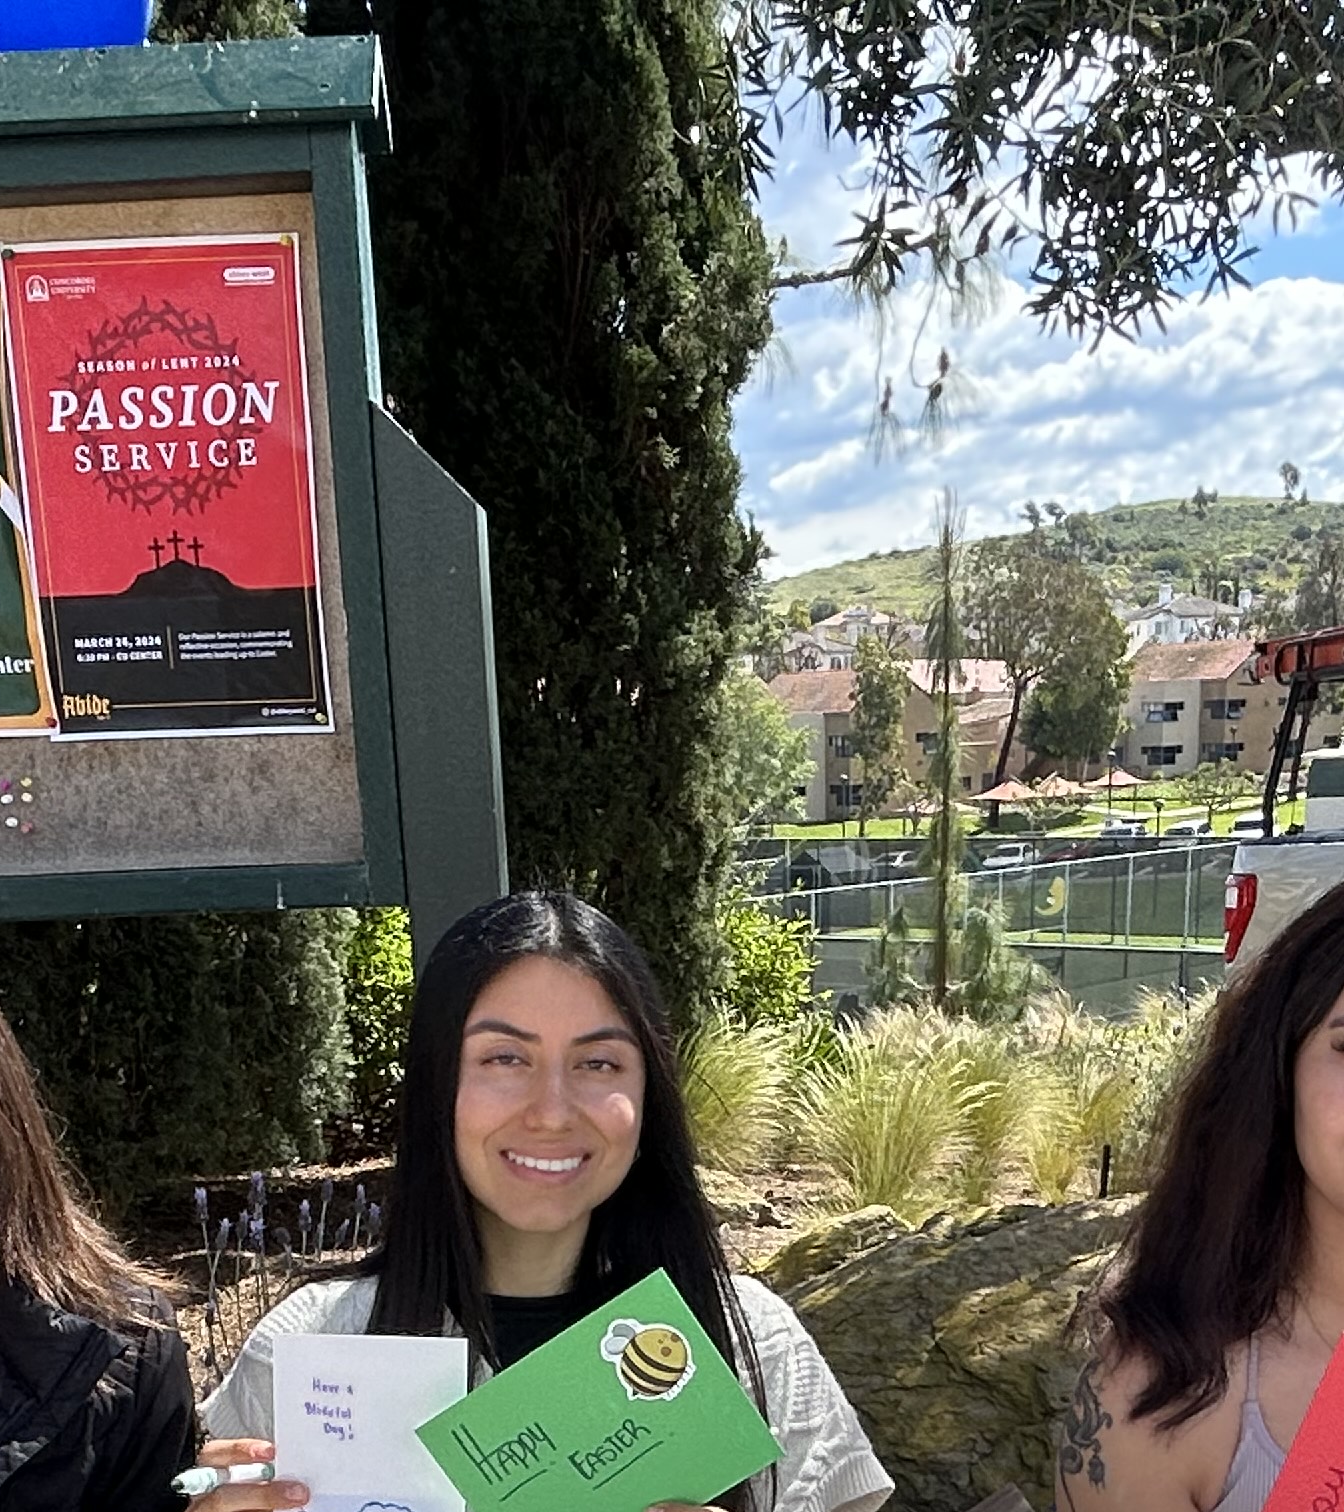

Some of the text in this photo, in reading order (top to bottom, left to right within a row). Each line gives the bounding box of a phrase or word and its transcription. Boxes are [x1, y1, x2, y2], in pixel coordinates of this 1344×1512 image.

[77, 355, 241, 373] SEASON of LENT 2024
[47, 380, 280, 433] PASSION
[74, 438, 258, 474] SERVICE
[74, 636, 113, 649] MARCH
[134, 635, 162, 647] 2024
[61, 693, 111, 719] Abide
[312, 1377, 339, 1394] Have
[323, 1422, 354, 1441] Day!
[567, 1419, 651, 1481] EASTER
